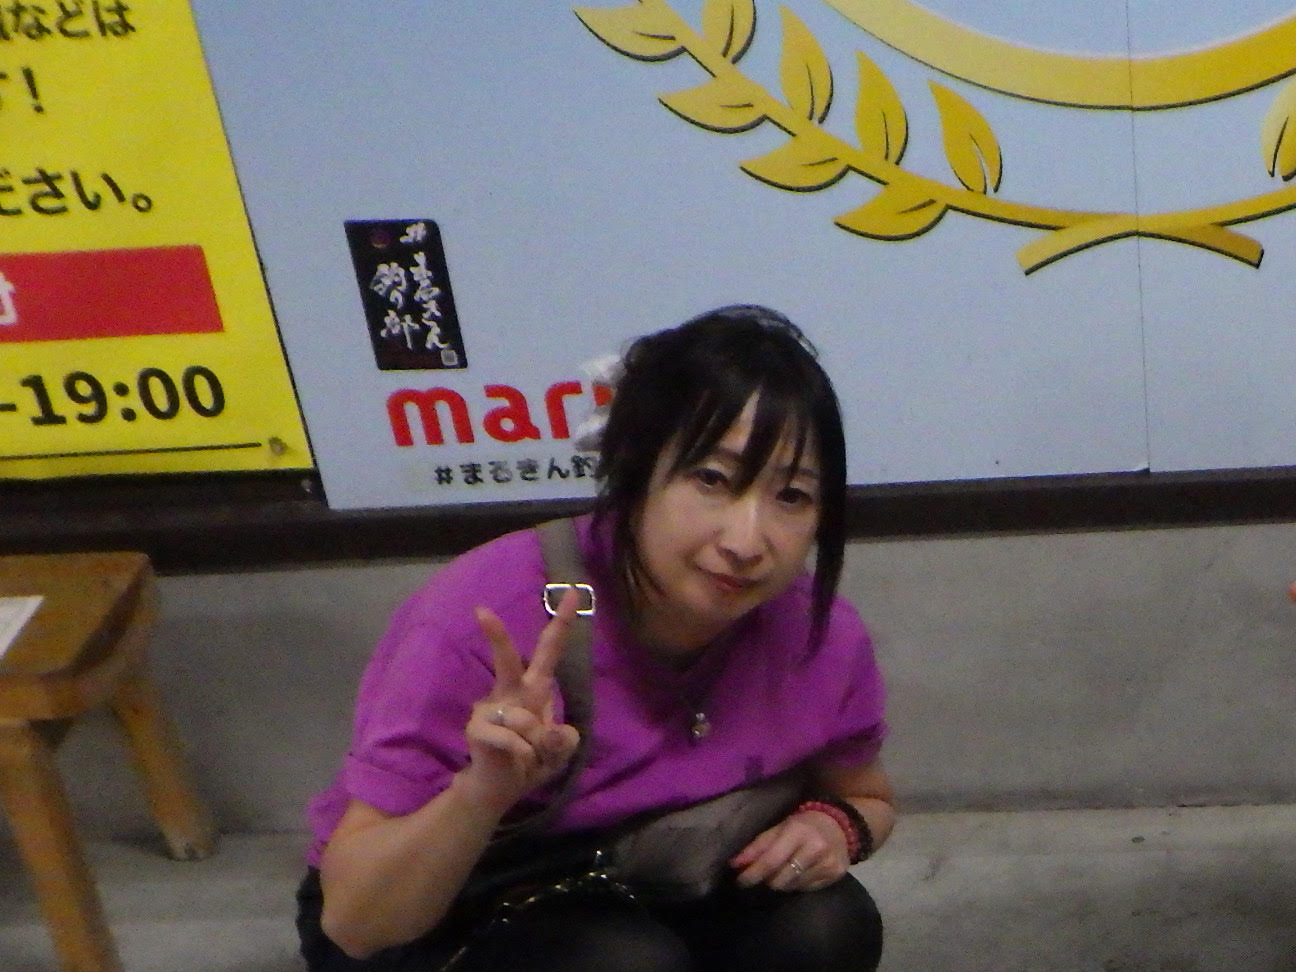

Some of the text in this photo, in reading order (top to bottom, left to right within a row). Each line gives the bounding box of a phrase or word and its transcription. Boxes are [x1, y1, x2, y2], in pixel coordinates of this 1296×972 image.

[0, 0, 136, 41] などは
[386, 380, 614, 447] mar
